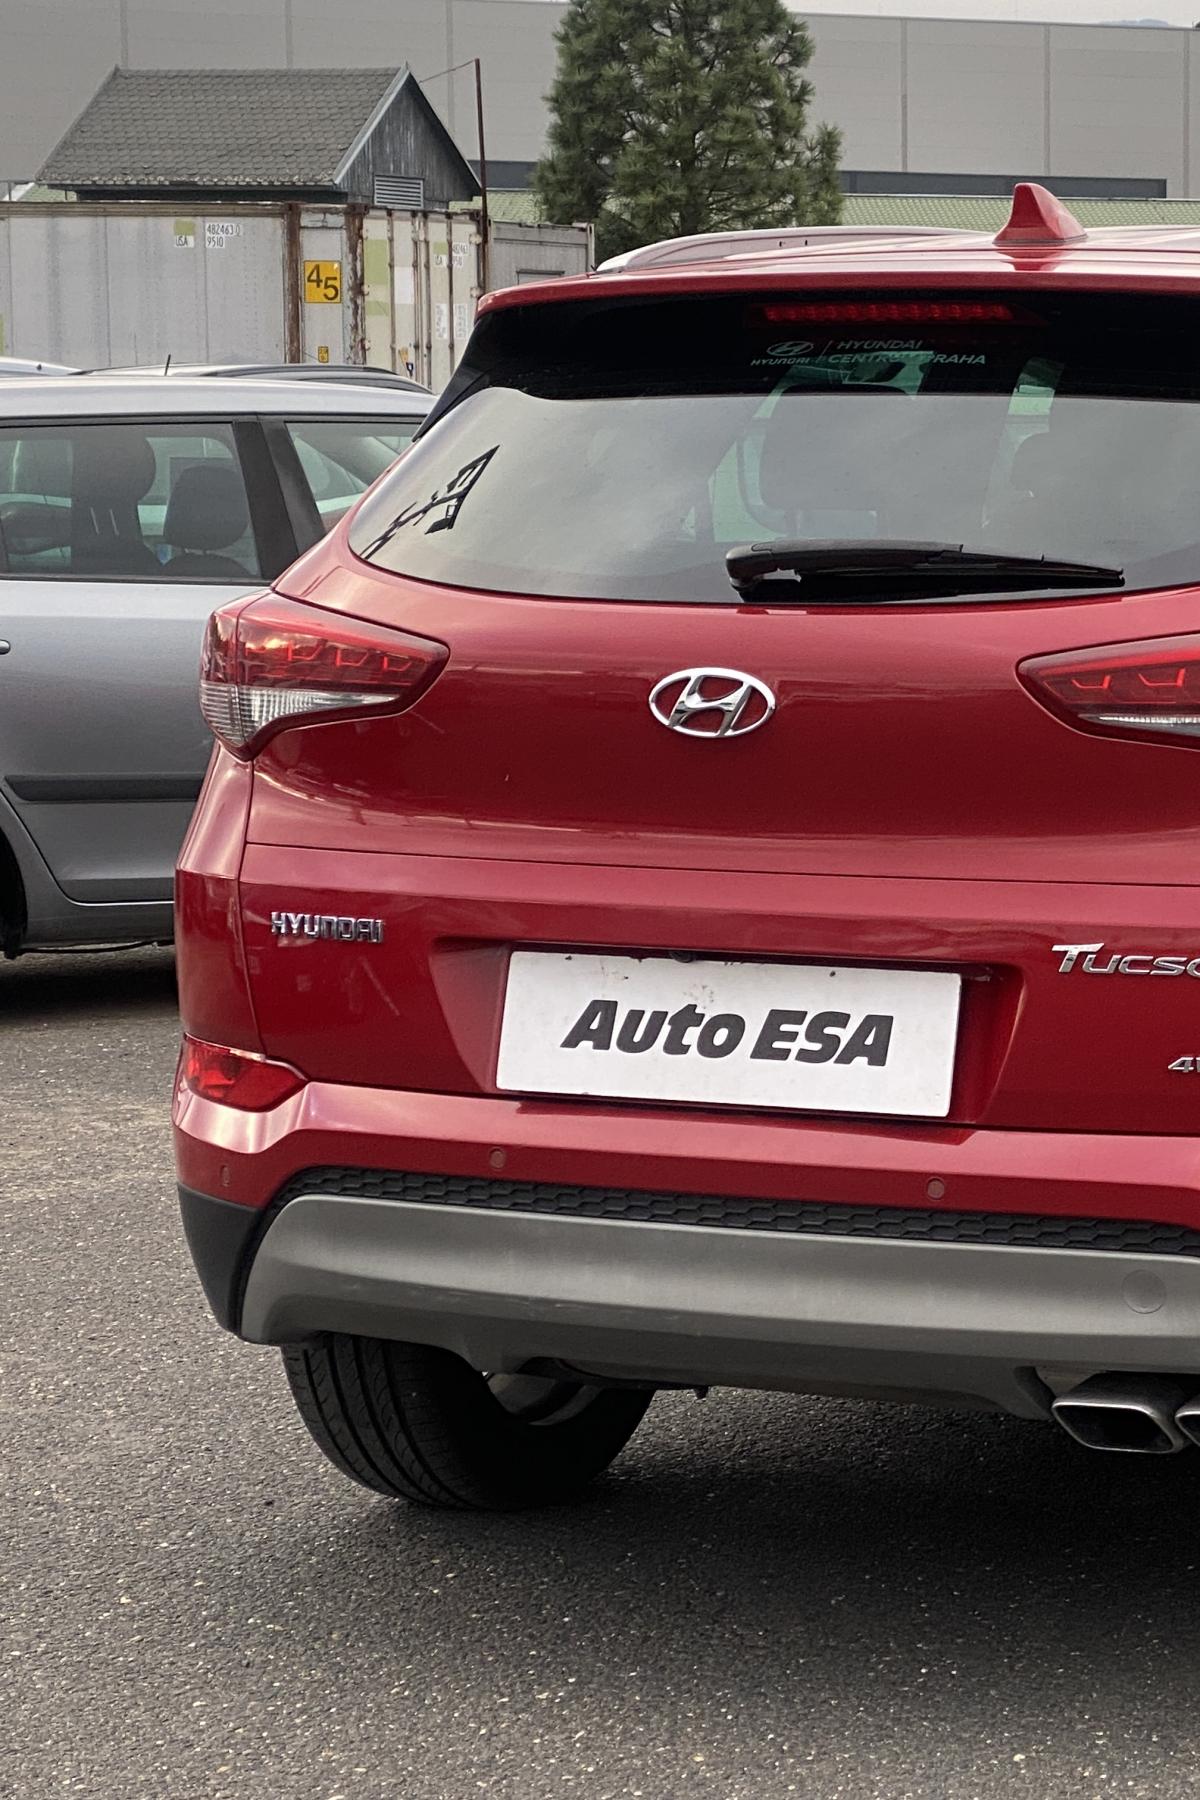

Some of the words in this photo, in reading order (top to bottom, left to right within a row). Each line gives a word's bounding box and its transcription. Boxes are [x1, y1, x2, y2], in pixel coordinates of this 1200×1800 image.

[837, 340, 924, 350] HYUNDAI
[751, 357, 811, 366] HYUNDAI
[828, 352, 922, 364] CENTRU
[927, 353, 986, 365] PRAHA
[271, 911, 384, 944] HYUNDAI
[560, 999, 746, 1059] Auto
[749, 1009, 894, 1067] ESA
